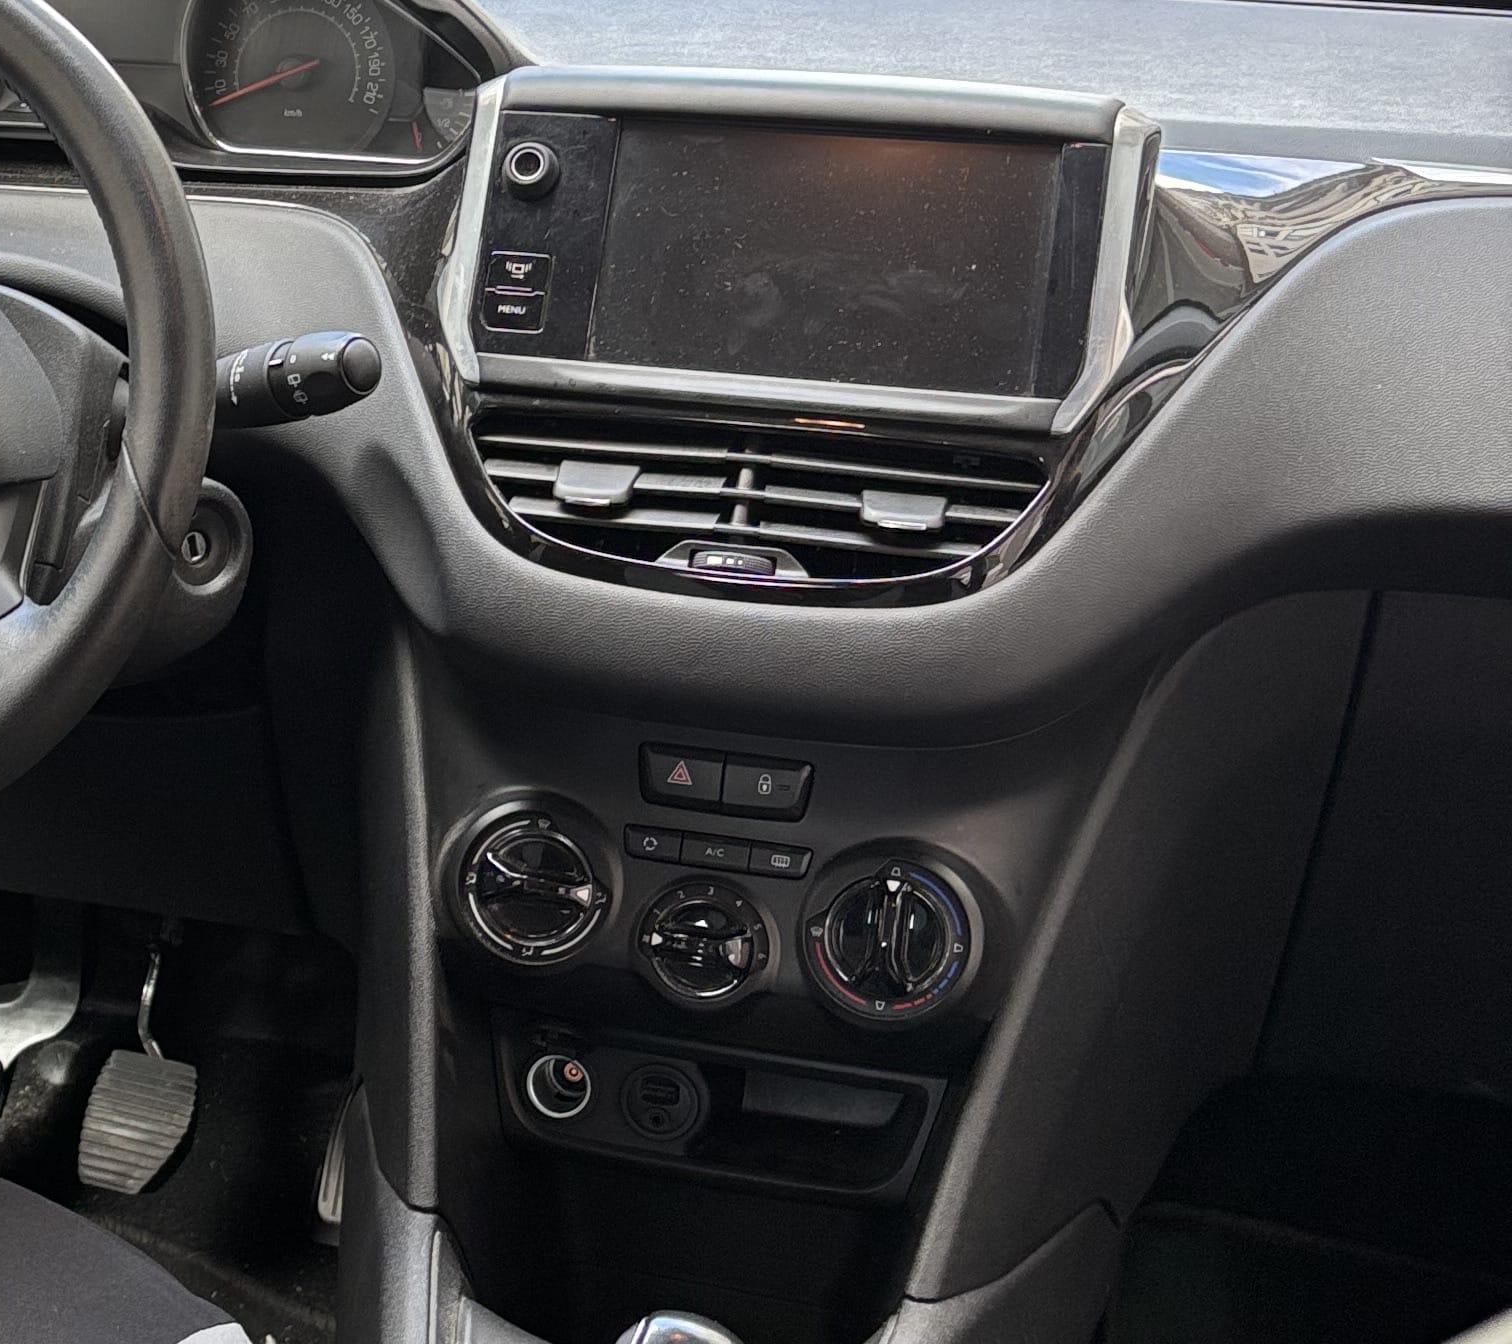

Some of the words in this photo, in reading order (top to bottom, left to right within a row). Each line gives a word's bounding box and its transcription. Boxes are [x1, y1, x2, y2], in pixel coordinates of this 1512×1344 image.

[242, 2, 259, 16] 70
[343, 4, 364, 26] 150
[224, 23, 241, 41] 50
[360, 26, 377, 49] 170
[215, 51, 229, 68] 30
[369, 52, 381, 77] 190
[363, 82, 379, 105] 210
[283, 108, 303, 118] km/h
[497, 304, 527, 315] MENU
[705, 847, 725, 857] A/C
[677, 890, 686, 899] 2
[707, 886, 715, 896] 3
